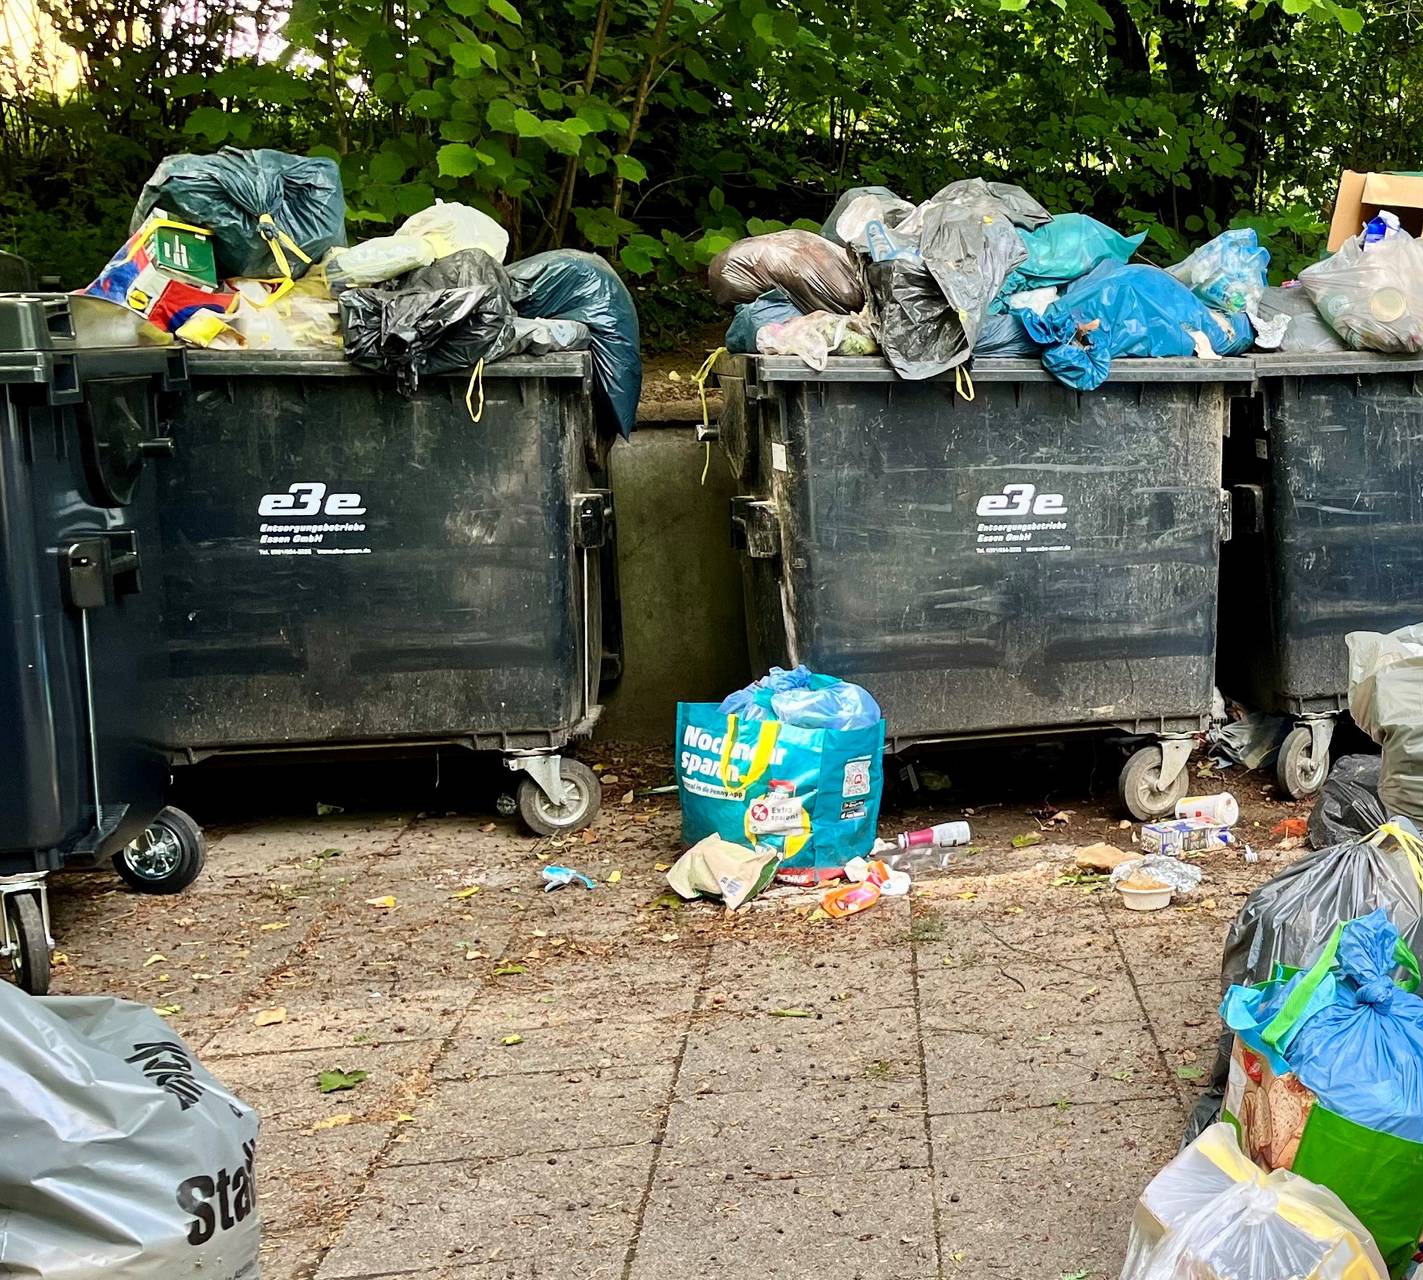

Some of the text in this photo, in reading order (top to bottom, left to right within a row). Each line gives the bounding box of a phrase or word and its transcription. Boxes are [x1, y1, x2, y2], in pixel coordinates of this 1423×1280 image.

[258, 483, 366, 516] e3e
[976, 484, 1068, 516] e3e
[260, 523, 366, 533] Entsorgungsbetriebe
[977, 522, 1067, 532] Entsorgungsbetriebe
[977, 532, 1032, 543] Essen GmbH
[260, 534, 323, 543] Essen GmbH
[683, 725, 730, 756] Noc
[681, 751, 741, 783] sparn
